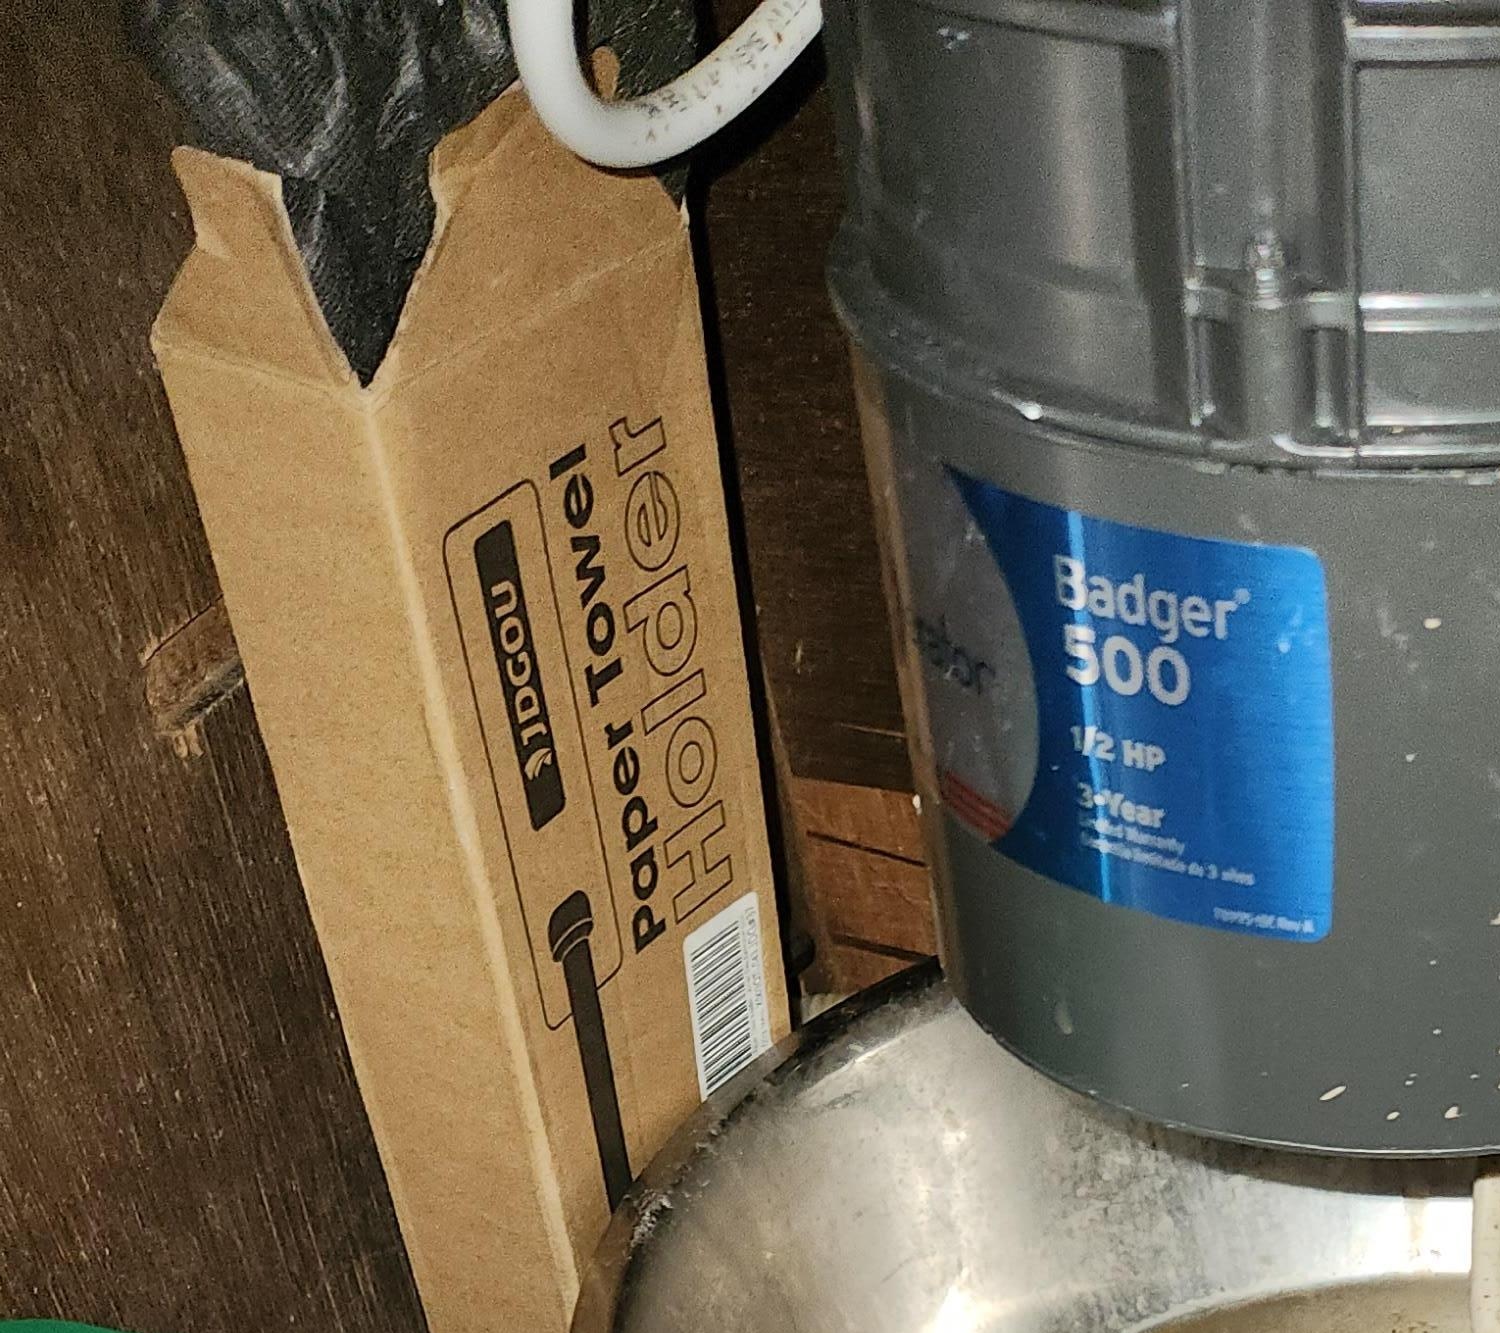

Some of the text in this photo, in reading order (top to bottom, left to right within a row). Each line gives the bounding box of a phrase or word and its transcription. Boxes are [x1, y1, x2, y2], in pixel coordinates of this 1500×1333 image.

[490, 580, 548, 746] JDGOU
[549, 444, 666, 954] Paper Towel
[608, 416, 733, 925] Holder
[1064, 624, 1191, 706] 500
[1071, 725, 1167, 771] 1/2 HP
